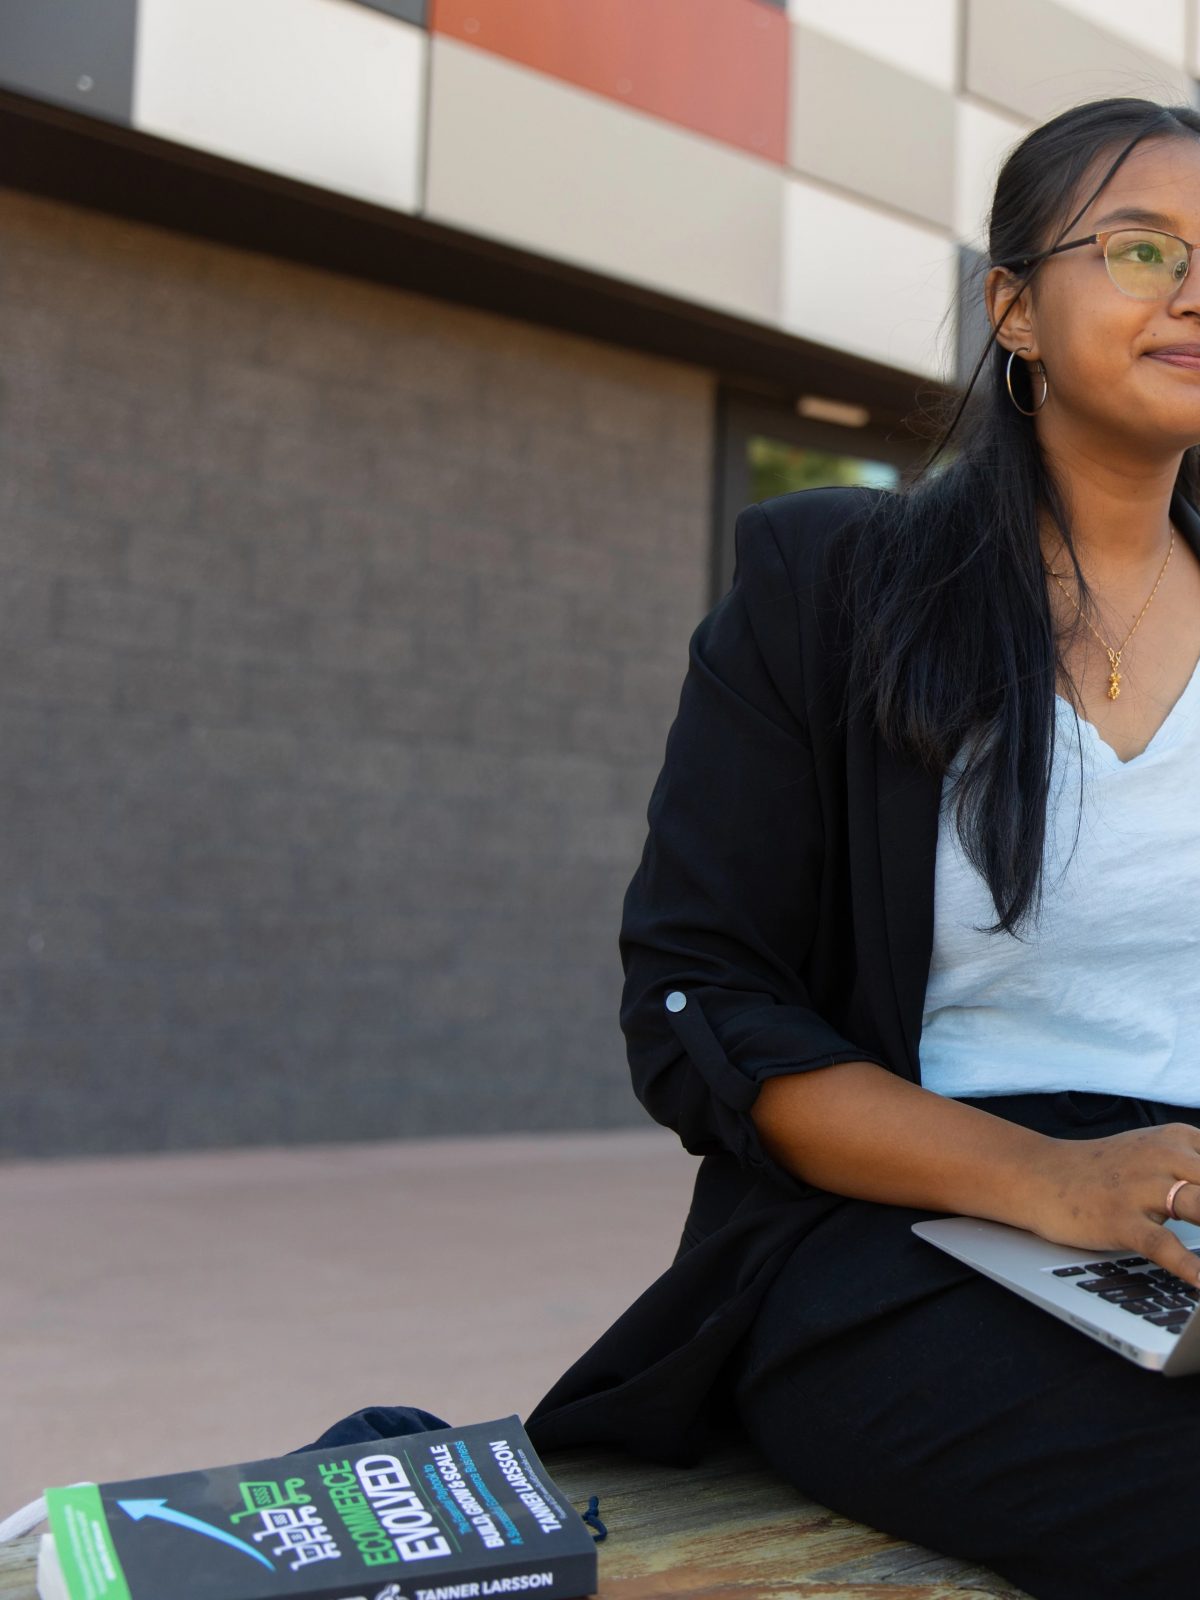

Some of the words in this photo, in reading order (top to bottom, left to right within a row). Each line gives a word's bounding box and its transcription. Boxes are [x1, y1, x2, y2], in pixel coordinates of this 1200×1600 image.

[423, 1464, 435, 1473] to
[430, 1443, 461, 1481] SCALE
[454, 1440, 478, 1473] Business
[489, 1440, 534, 1493] LARSSON
[425, 1472, 450, 1502] Playbook
[447, 1480, 466, 1489] &
[469, 1473, 499, 1507] Ecommerce
[318, 1459, 399, 1567] ECOMMERCE
[355, 1454, 452, 1562] EVOLVED
[451, 1488, 484, 1516] GROW
[520, 1491, 562, 1534] TANNER
[471, 1513, 505, 1549] BUILD,
[416, 1583, 480, 1600] TANNER
[482, 1572, 553, 1595] LARSSON
